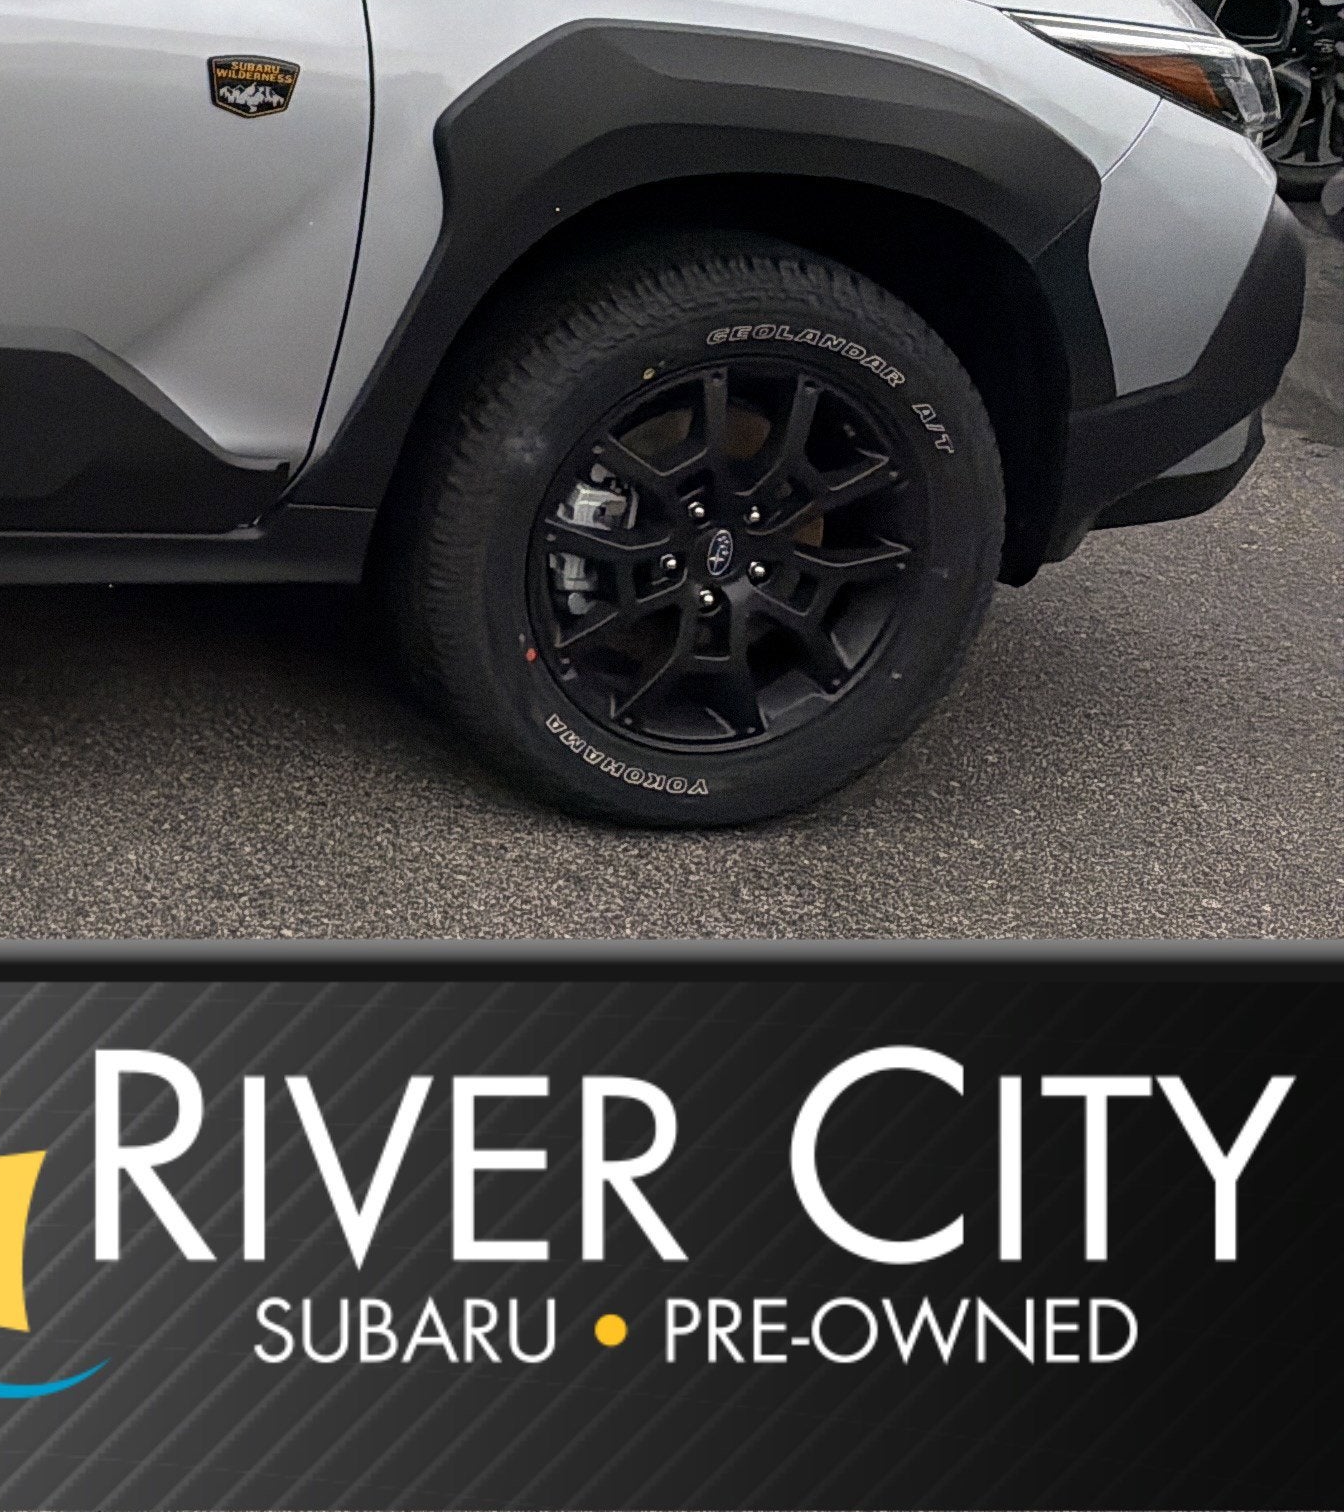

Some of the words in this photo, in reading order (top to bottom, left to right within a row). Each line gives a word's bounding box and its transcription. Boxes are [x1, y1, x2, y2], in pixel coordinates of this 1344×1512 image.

[216, 68, 293, 84] WILDERNESS
[231, 61, 280, 74] SUBARU
[706, 323, 906, 388] GEOLANDAR
[911, 403, 955, 454] A/T
[545, 713, 709, 795] YOKOHAMA
